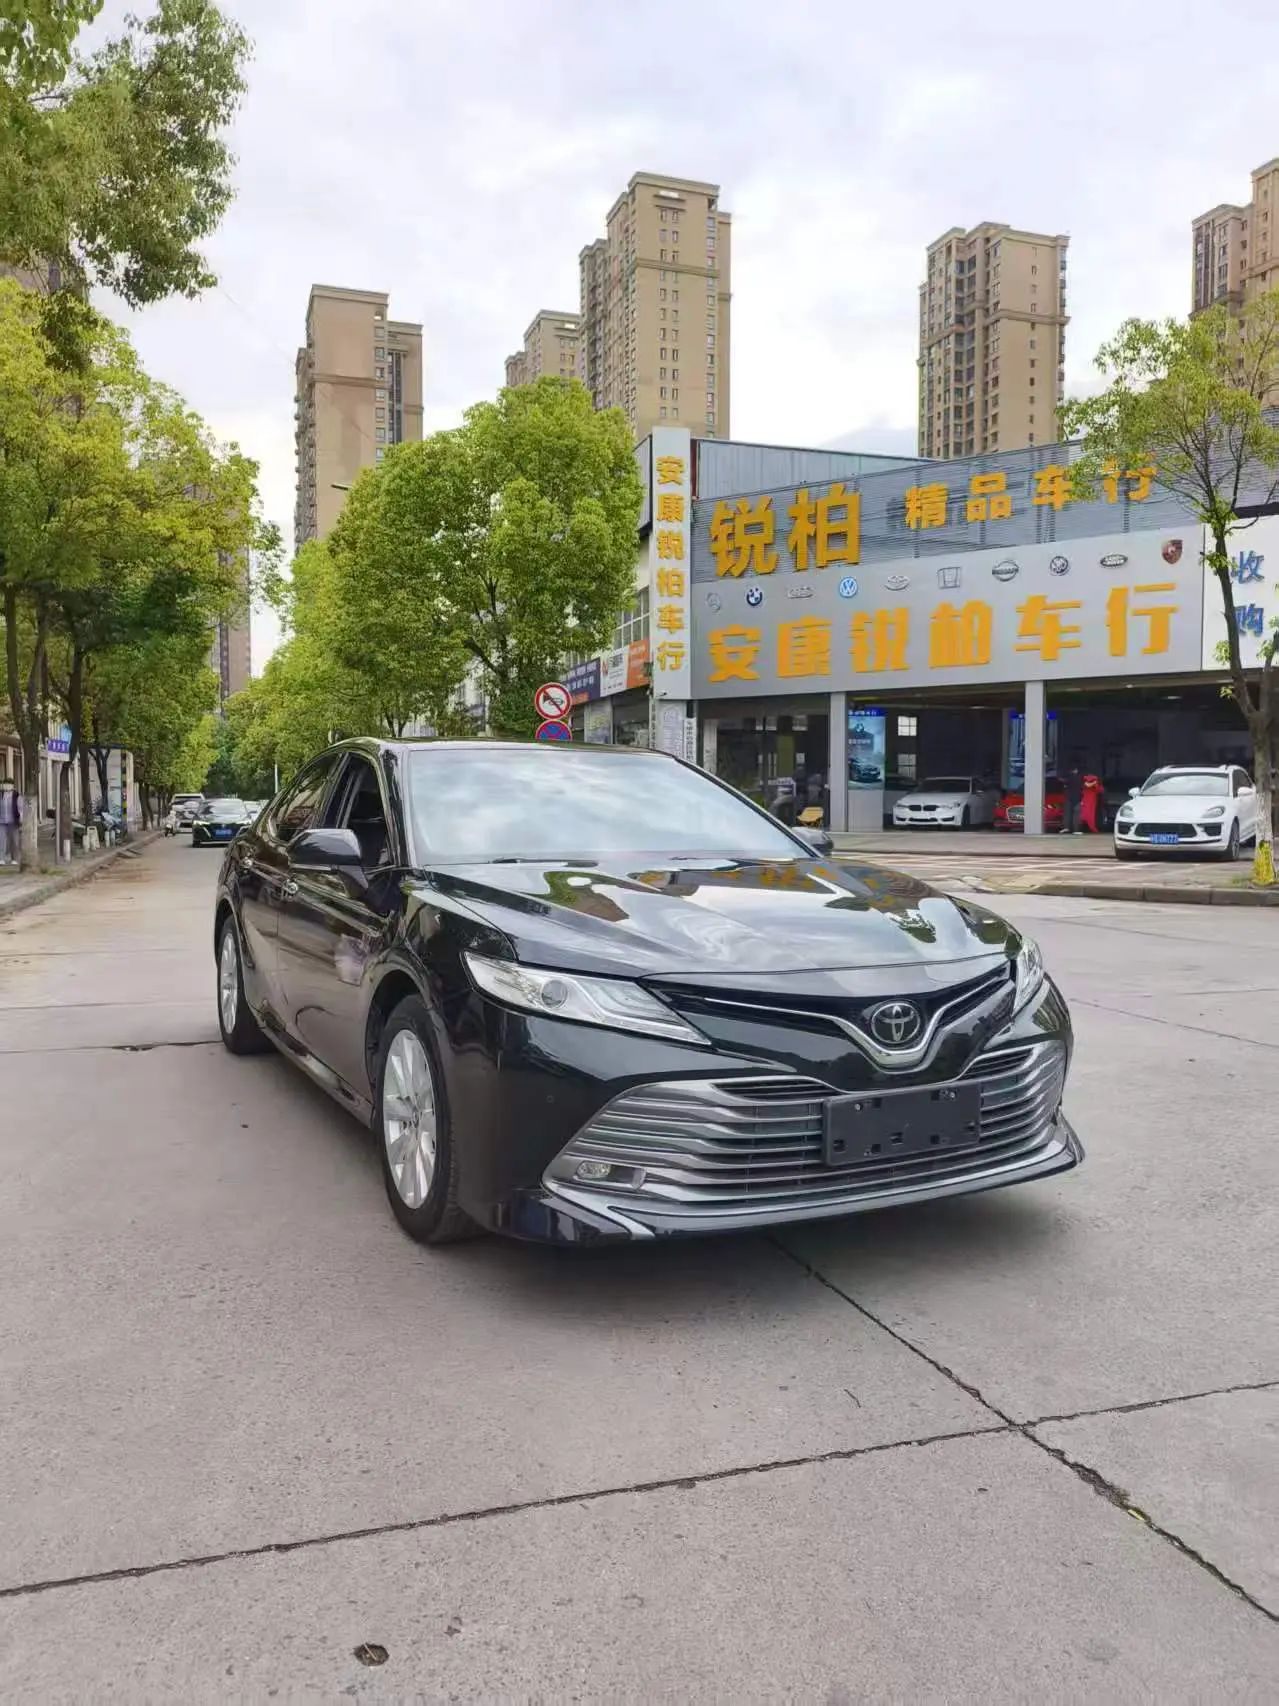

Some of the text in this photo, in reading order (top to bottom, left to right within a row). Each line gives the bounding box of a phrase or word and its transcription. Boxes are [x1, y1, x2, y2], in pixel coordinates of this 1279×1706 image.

[656, 456, 685, 671] 安康锐柏车行
[708, 453, 1157, 577] 锐柏 精品车行
[707, 583, 1180, 682] 安康锐柏车行
[1232, 550, 1264, 637] 收购
